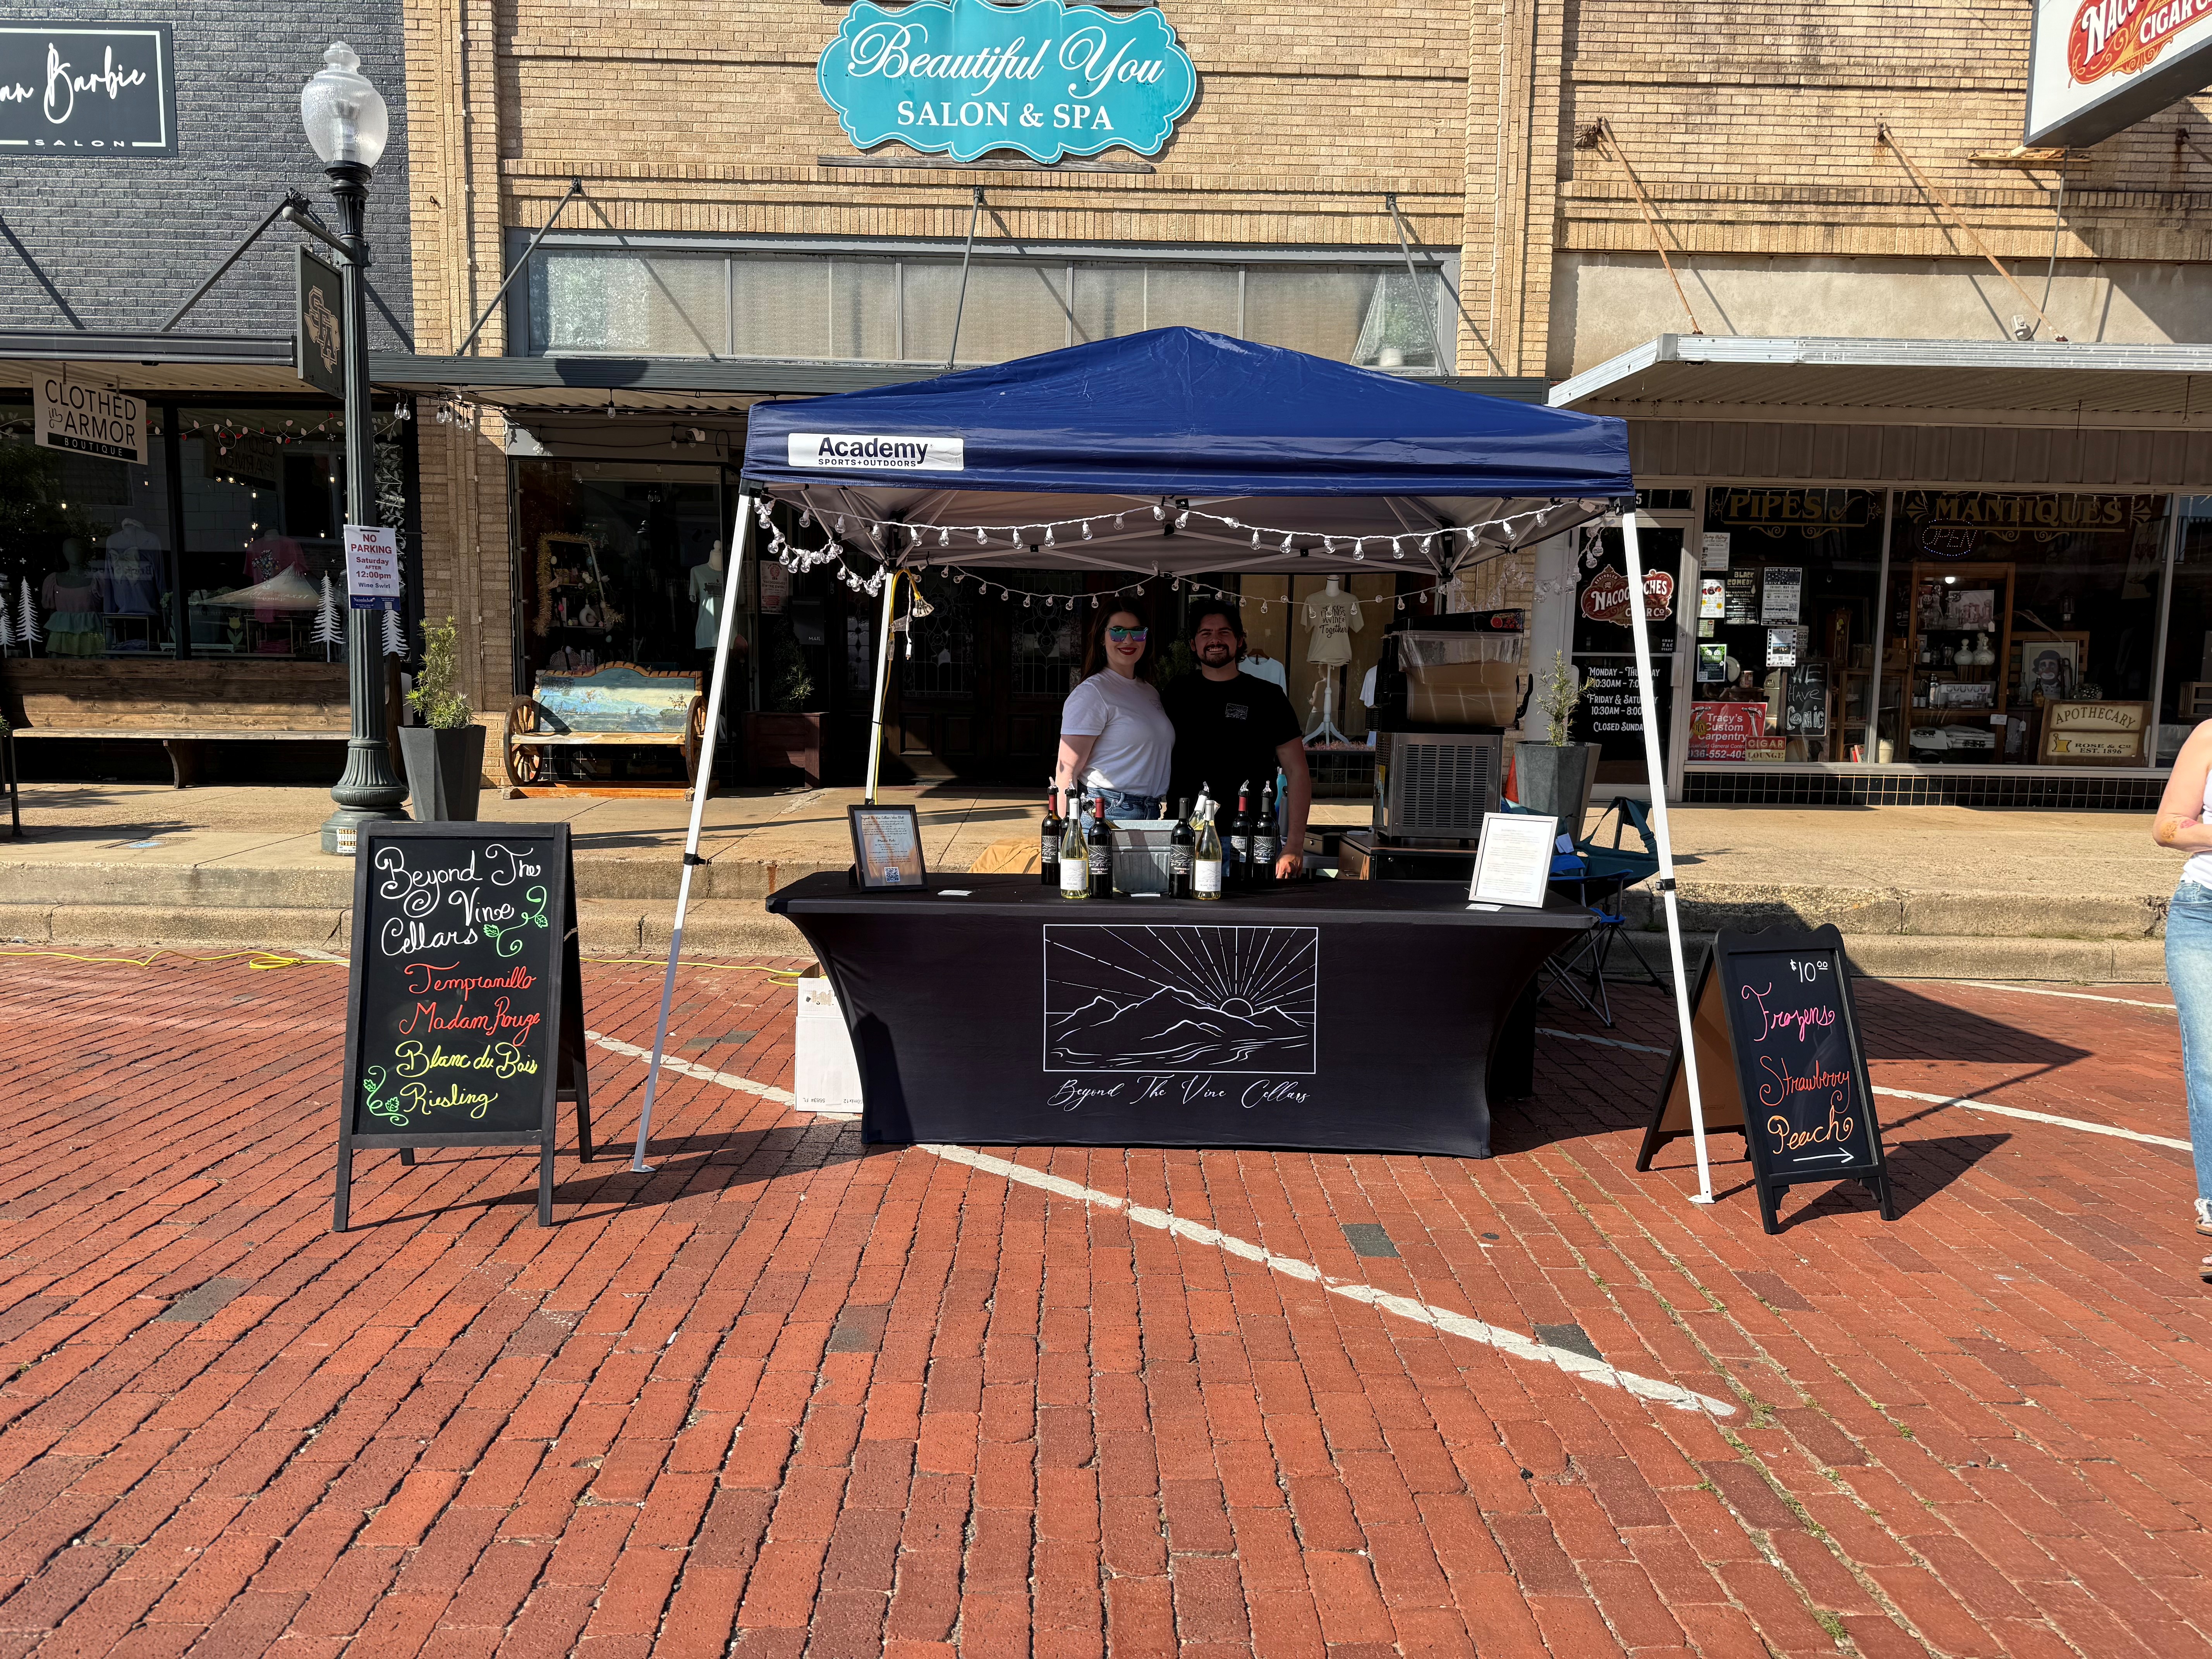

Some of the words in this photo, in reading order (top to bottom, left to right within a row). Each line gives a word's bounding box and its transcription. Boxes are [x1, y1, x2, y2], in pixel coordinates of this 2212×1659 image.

[847, 22, 1052, 96] Beautiful
[1059, 26, 1166, 99] You
[43, 43, 146, 124] Barbie
[898, 101, 1008, 127] SALON
[1019, 103, 1044, 128] &
[1053, 103, 1114, 130] SPA
[35, 139, 124, 147] SALON
[45, 379, 136, 421] CLOTHED
[48, 407, 63, 429] in
[64, 411, 136, 447] ARMOR
[65, 437, 123, 457] BOUTIQUE
[818, 437, 928, 464] Academy
[1728, 495, 1823, 519] PIPES
[1936, 498, 2123, 527] MANTIQUES
[351, 544, 392, 554] PARKING
[363, 534, 377, 542] NO
[356, 556, 389, 565] Saturday
[356, 570, 391, 580] 12:00pm
[1319, 624, 1347, 638] Together
[1588, 667, 1618, 676] MONDAY
[1790, 663, 1825, 685] WE
[1587, 694, 1614, 704] FRIDAY
[1615, 694, 1621, 705] &
[1591, 706, 1620, 715] 10:30AM
[1593, 721, 1620, 732] CLOSED
[1621, 722, 1644, 731] SUNDA
[1705, 722, 1743, 732] Custom
[1707, 713, 1743, 724] Tracy's
[2056, 707, 2136, 728] APOTHECARY
[1698, 732, 1748, 743] Carpentry
[1748, 739, 1784, 749] CIGAR
[374, 846, 483, 918] Beyond
[485, 844, 541, 886] The
[448, 887, 514, 926] Vine
[381, 917, 478, 956] Cellars
[404, 961, 537, 1001] Tempranillo
[399, 1002, 488, 1034] Madam
[485, 996, 540, 1046] Rouge
[395, 1040, 471, 1078] Blanc
[472, 1044, 494, 1069] du
[1047, 1079, 1125, 1111] Beyond
[1130, 1074, 1175, 1104] The
[1182, 1074, 1226, 1104] Vine
[1241, 1079, 1310, 1108] Cellars
[1759, 1056, 1850, 1114] Strawberry
[399, 1082, 498, 1119] Riesling
[1767, 1105, 1853, 1154] Peach
